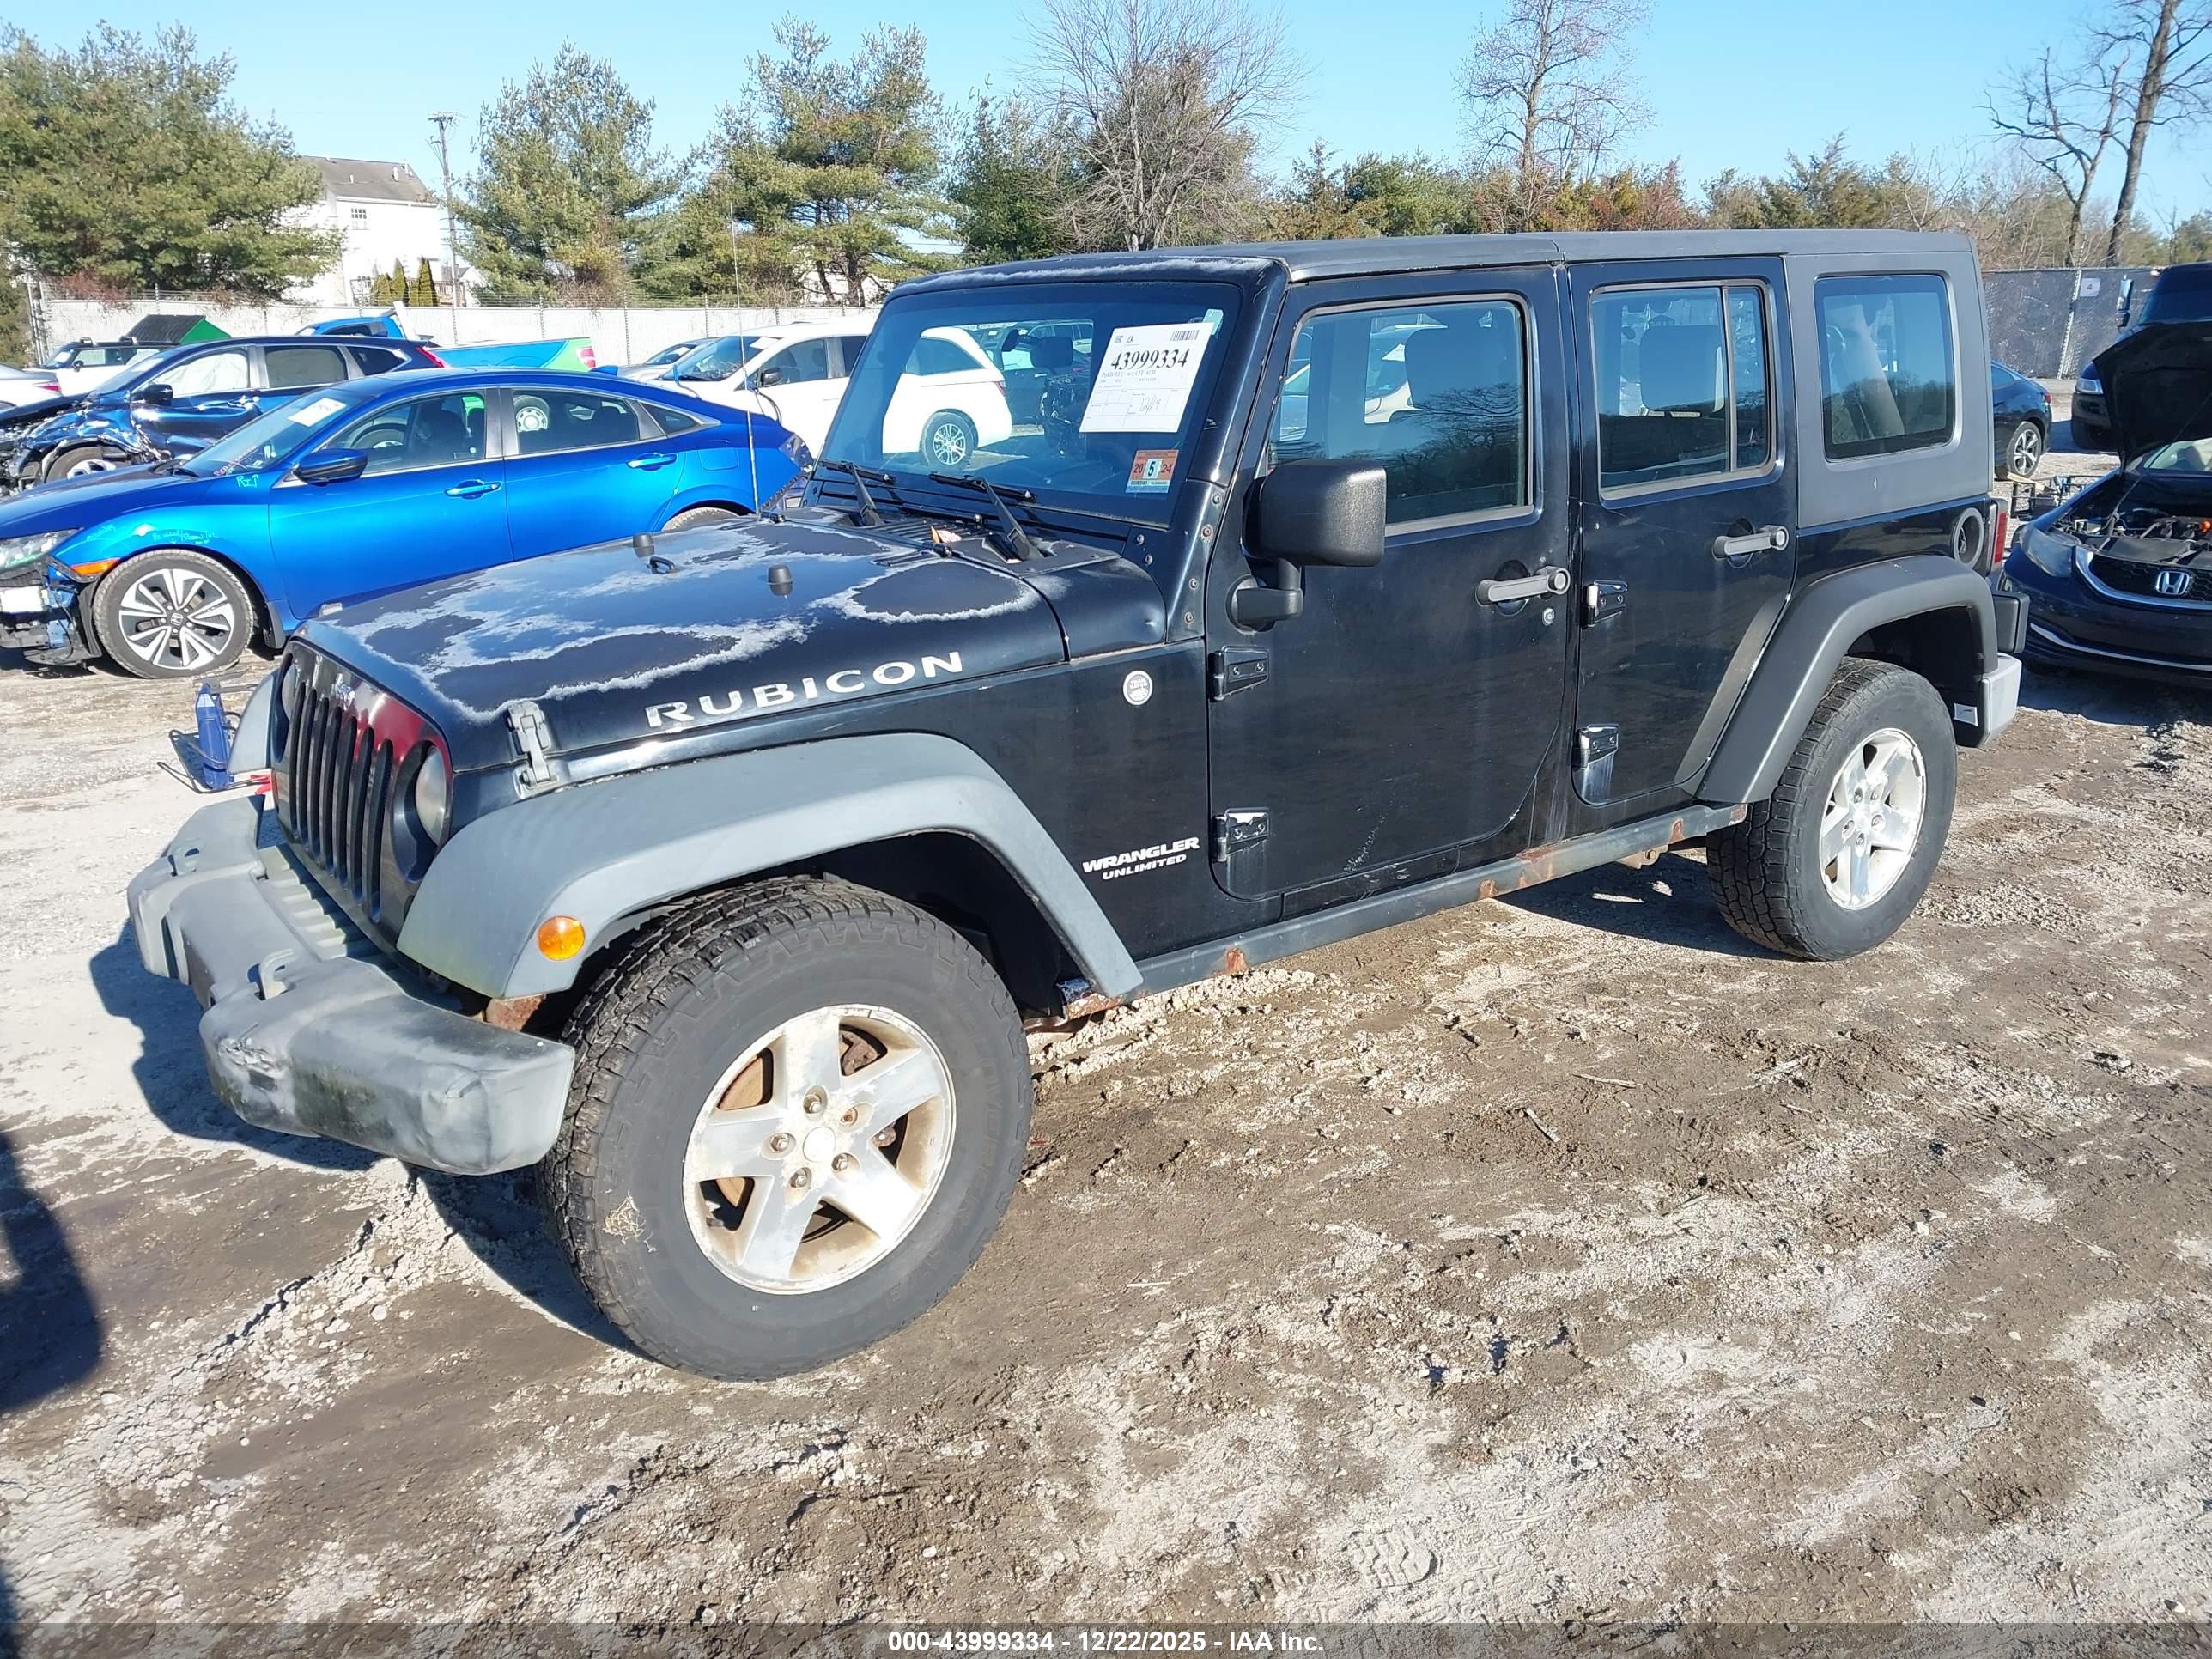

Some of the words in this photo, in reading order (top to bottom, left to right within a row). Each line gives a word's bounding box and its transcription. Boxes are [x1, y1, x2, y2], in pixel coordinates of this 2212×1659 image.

[1110, 348, 1190, 370] 43999334
[1133, 464, 1144, 473] 20
[1147, 461, 1156, 477] 5
[1161, 464, 1172, 473] 24
[645, 651, 963, 728] RUBICON
[1082, 836, 1200, 873] WRANGLER
[1102, 854, 1187, 880] UNLIMITED
